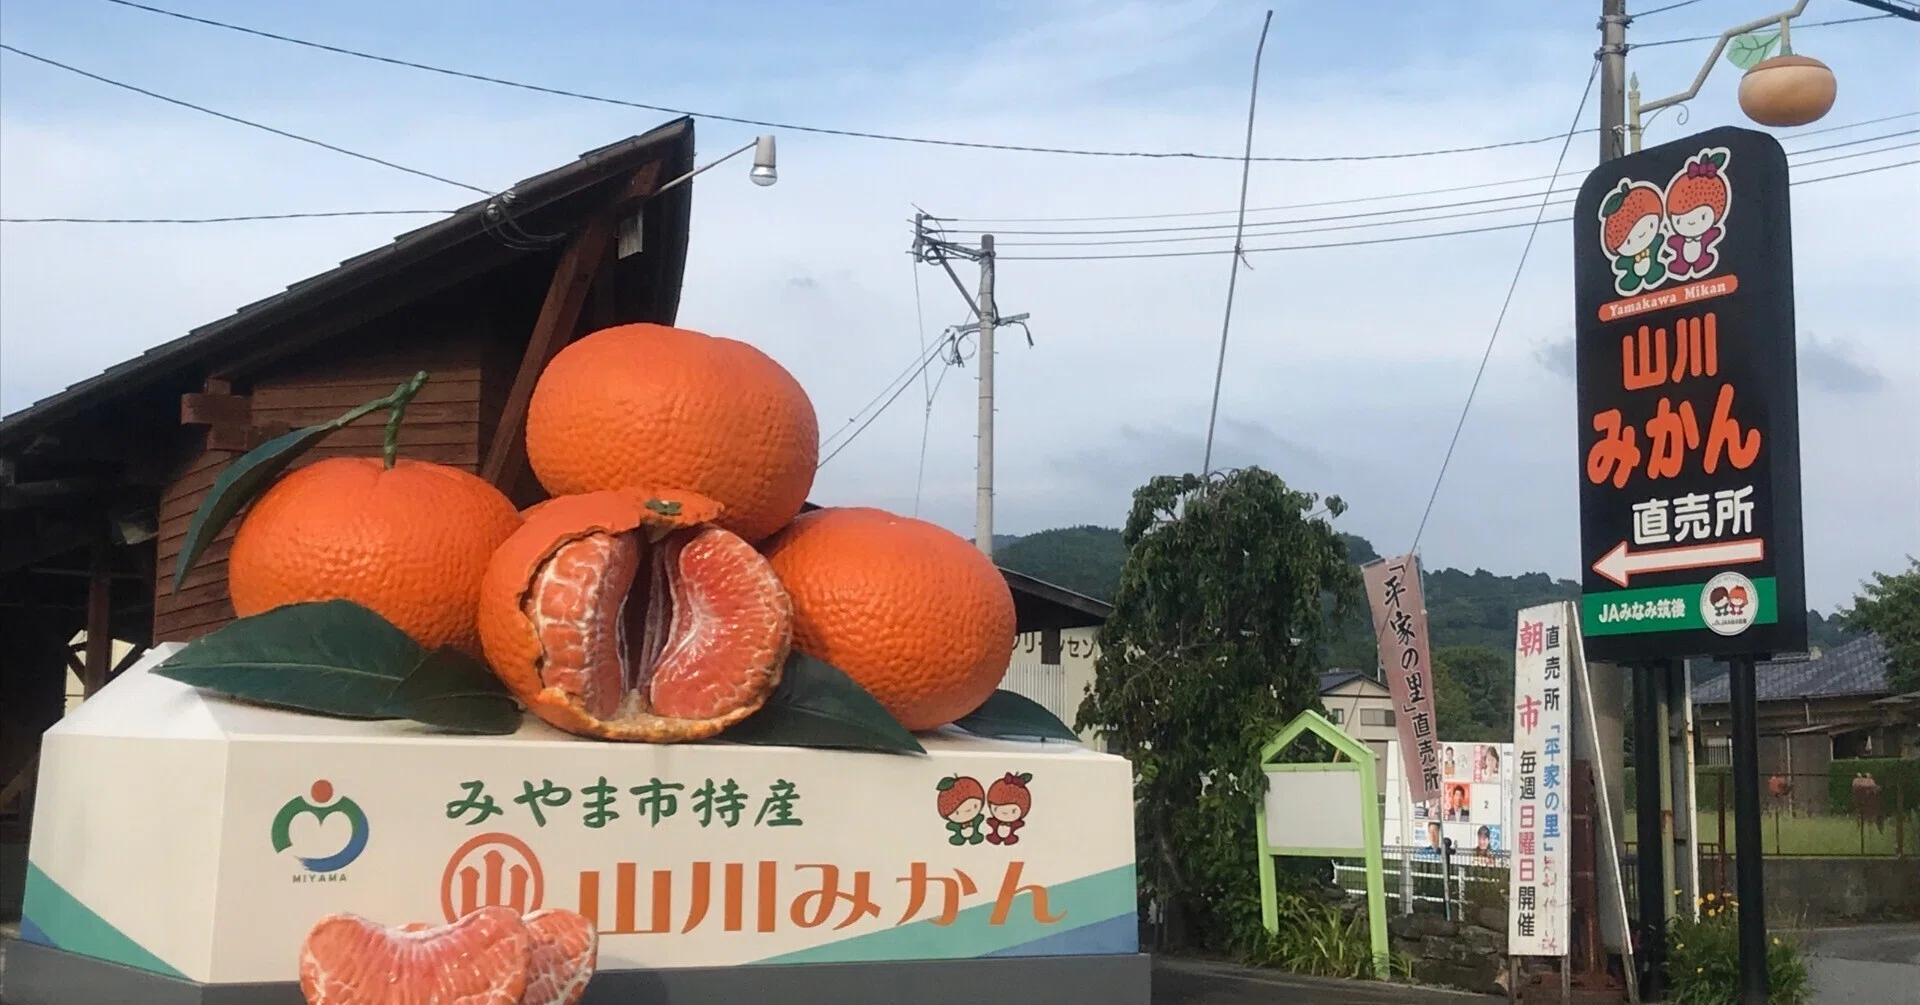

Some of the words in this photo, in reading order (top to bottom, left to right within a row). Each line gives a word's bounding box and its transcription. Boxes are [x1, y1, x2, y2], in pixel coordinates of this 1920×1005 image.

[1608, 294, 1677, 318] Yamakawa
[1684, 280, 1727, 301] Mikan
[1622, 312, 1718, 391] 山川
[1586, 383, 1761, 489] みかん
[1632, 485, 1754, 545] 直売所
[1516, 620, 1544, 735] 朝市
[446, 775, 803, 829] みやま市特産
[291, 872, 348, 884] MIYAMA
[579, 860, 1068, 934] 山川みかん
